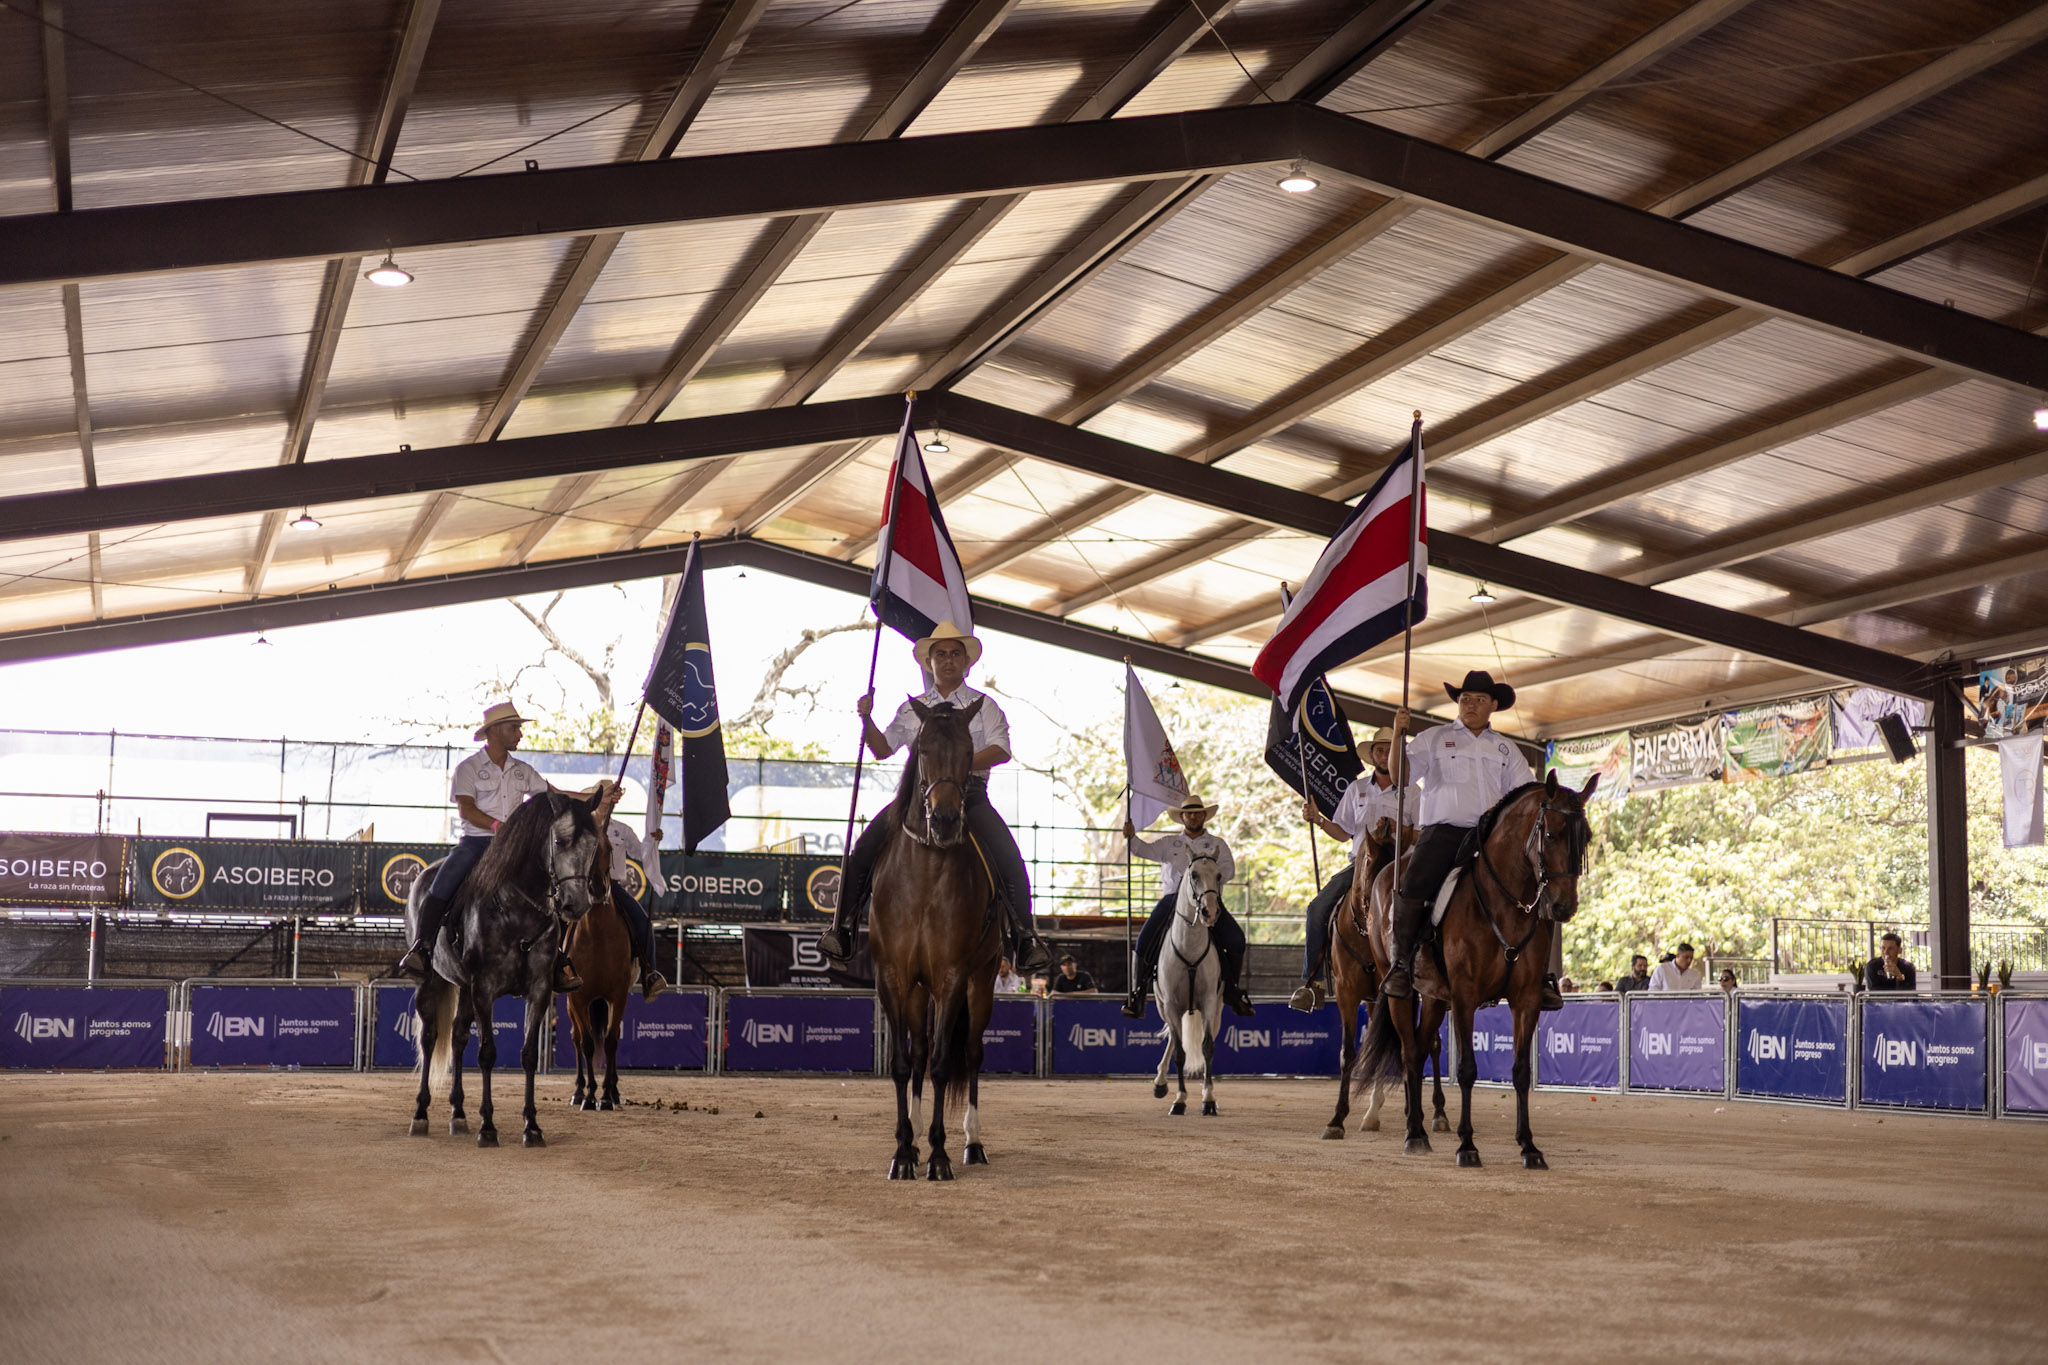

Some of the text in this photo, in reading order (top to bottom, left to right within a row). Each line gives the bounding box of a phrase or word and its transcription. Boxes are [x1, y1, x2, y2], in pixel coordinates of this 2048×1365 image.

[1633, 727, 1721, 774] ENFORMA
[212, 866, 335, 887] ASOIBERO
[71, 883, 105, 892] fronteras
[301, 894, 333, 902] fronteras
[89, 1019, 151, 1028] Juntos somos
[225, 1017, 264, 1037] BN
[279, 1018, 339, 1027] Juntos somos
[637, 1021, 664, 1030] Juntos
[33, 1018, 74, 1038] BN
[89, 1028, 131, 1038] progreso
[279, 1027, 319, 1036] progreso
[806, 1026, 832, 1034] Juntos
[637, 1030, 675, 1039] progreso
[758, 1024, 794, 1043] BN
[806, 1034, 843, 1043] progreso
[1084, 1029, 1117, 1046] BN
[1127, 1030, 1153, 1038] Juntos
[1238, 1030, 1270, 1047] BN
[1281, 1031, 1305, 1039] Juntos
[982, 1036, 1004, 1045] greso
[1127, 1038, 1162, 1047] progreso
[1281, 1039, 1314, 1047] progreso
[1472, 1031, 1489, 1051] BN
[1554, 1033, 1574, 1054] BN
[1580, 1035, 1612, 1044] Juntos somos
[1649, 1033, 1672, 1055] BN
[1679, 1035, 1715, 1045] Juntos somos
[1794, 1038, 1836, 1051] Juntos somos
[1580, 1044, 1602, 1055] progreso
[1679, 1045, 1704, 1055] progreso
[1759, 1035, 1786, 1060] BN
[1926, 1043, 1975, 1055] Juntos somos
[1794, 1050, 1822, 1061] progreso
[1887, 1040, 1916, 1066] BN
[1926, 1055, 1959, 1067] progreso
